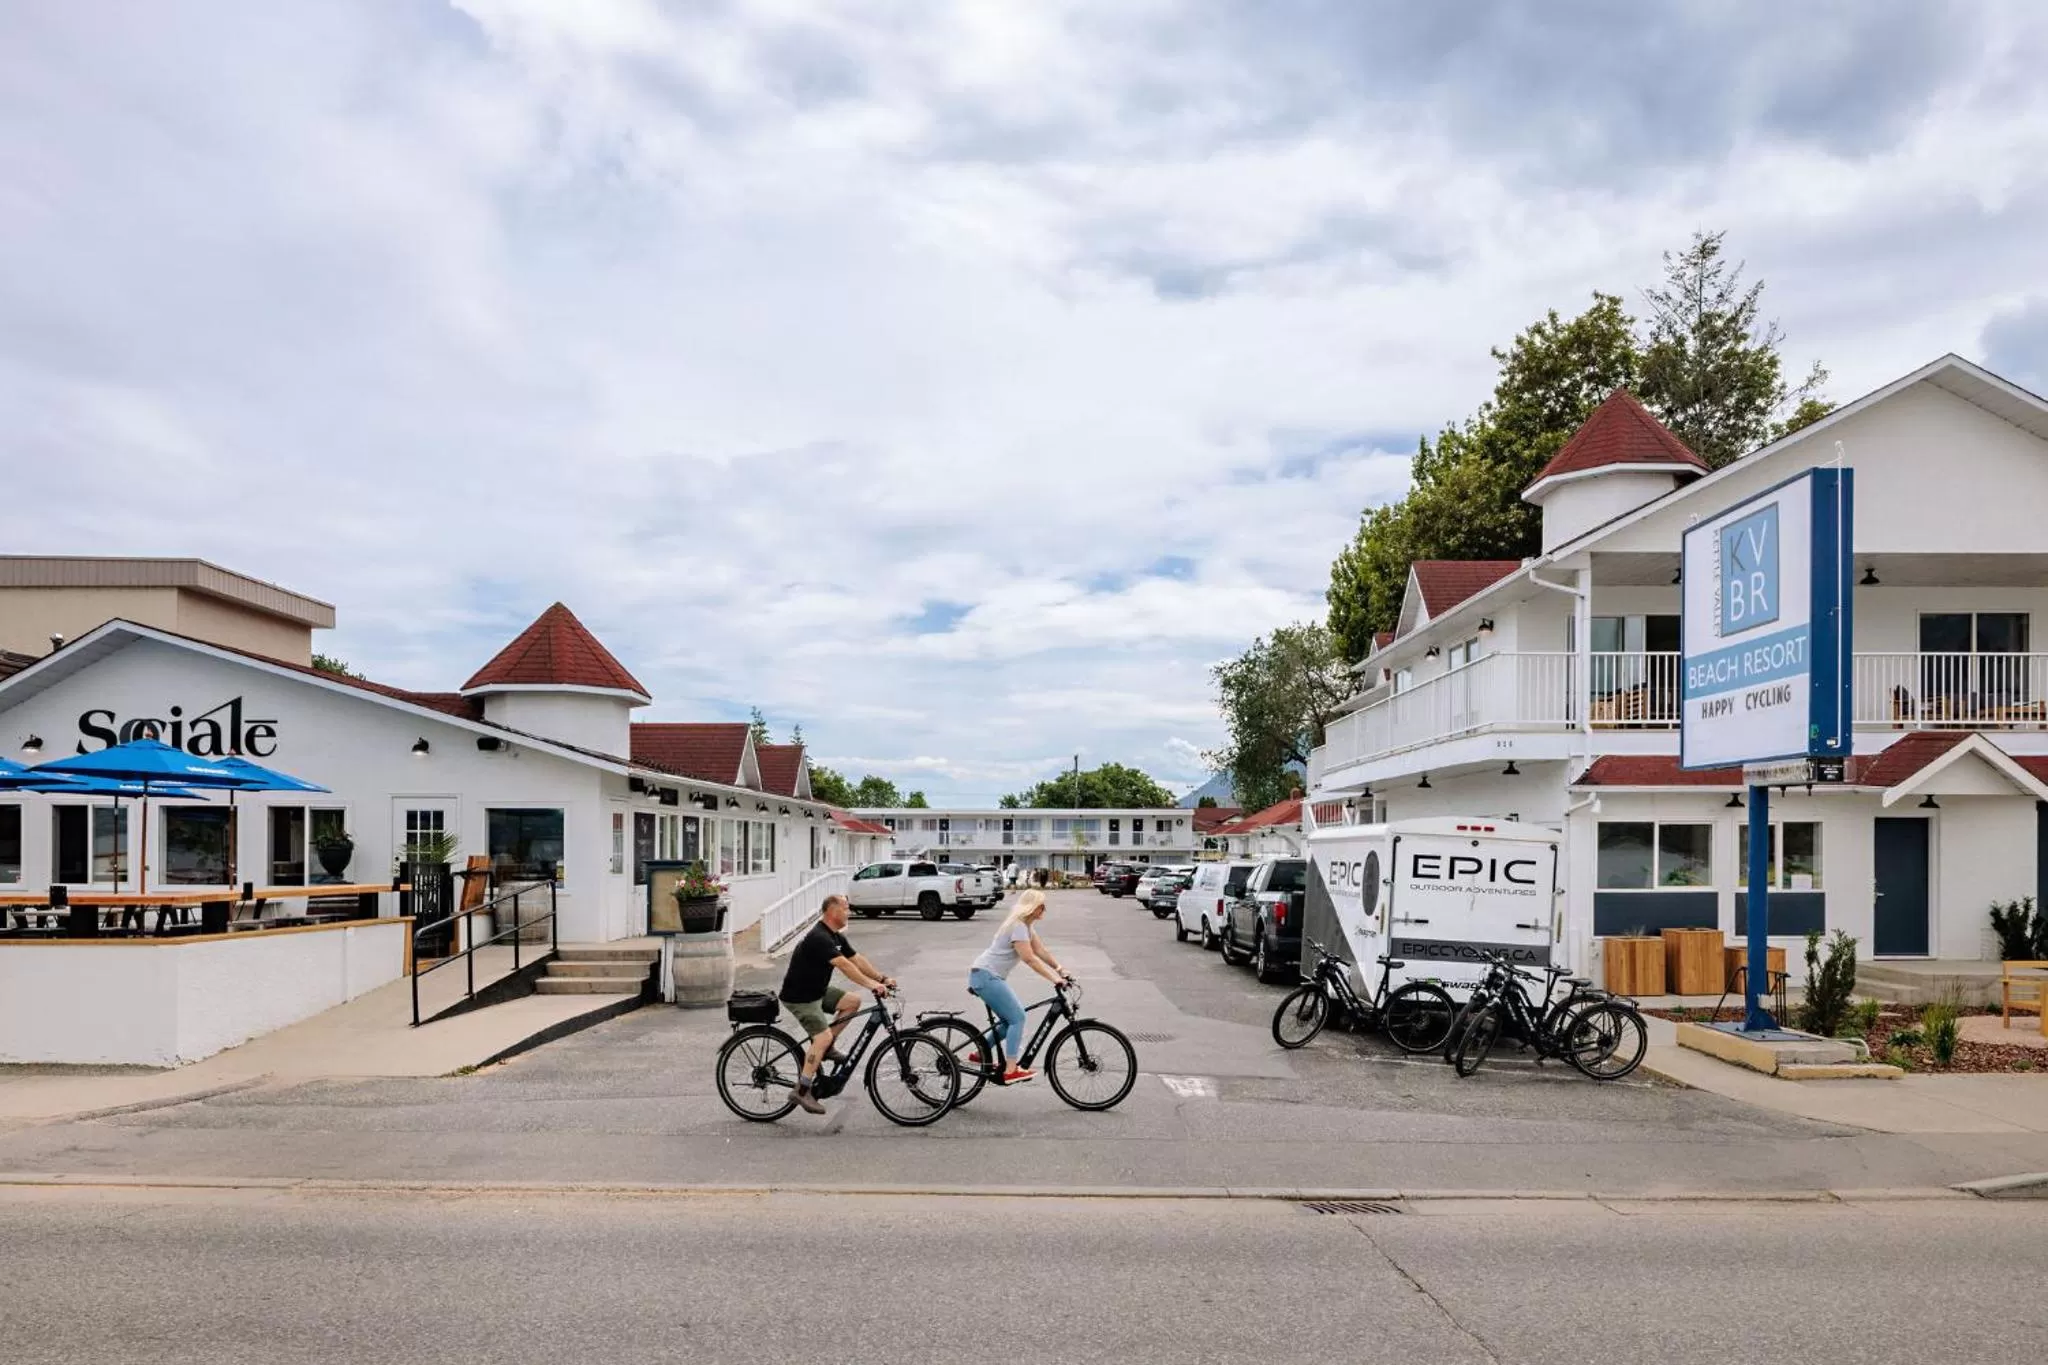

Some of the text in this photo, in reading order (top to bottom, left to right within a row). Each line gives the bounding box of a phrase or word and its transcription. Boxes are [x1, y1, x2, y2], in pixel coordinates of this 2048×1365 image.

[1688, 636, 1807, 689] BEACH RESORT
[1702, 684, 1792, 719] HAPPY CYCLING
[1329, 861, 1362, 887] EPIC
[1412, 854, 1537, 885] EPIC
[1410, 884, 1537, 896] OUTDOOR ADVENTURES
[1402, 942, 1537, 962] EPICCYCNG.CA
